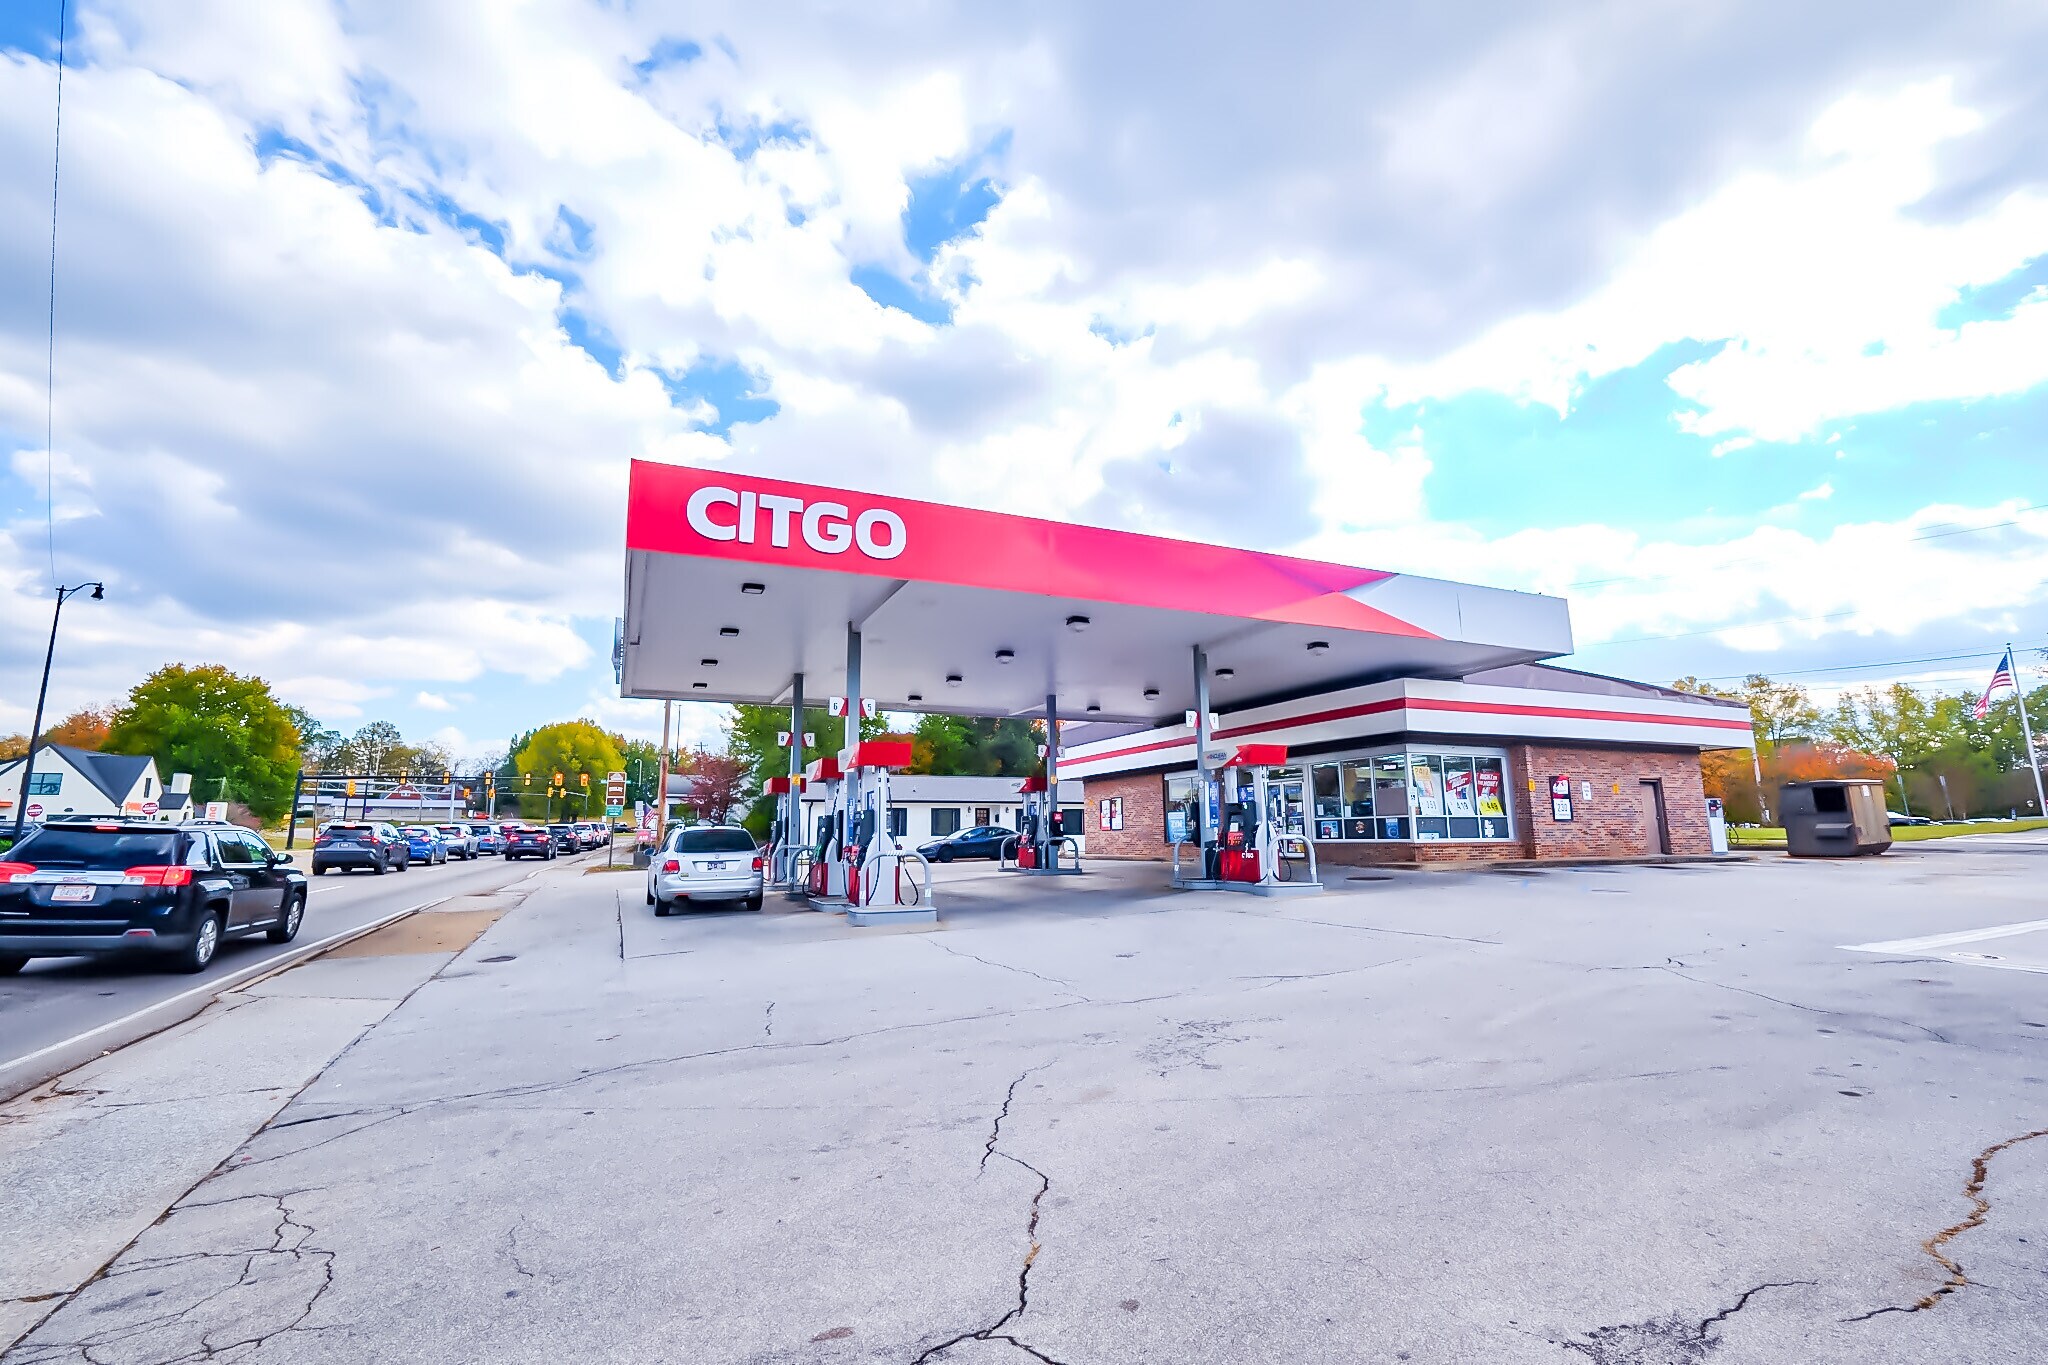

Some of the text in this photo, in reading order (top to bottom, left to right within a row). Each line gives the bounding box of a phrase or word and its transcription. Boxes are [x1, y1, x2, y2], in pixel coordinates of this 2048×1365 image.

[686, 486, 907, 560] CITGO
[833, 702, 838, 710] 6
[867, 703, 872, 711] 5
[1188, 714, 1193, 722] 2
